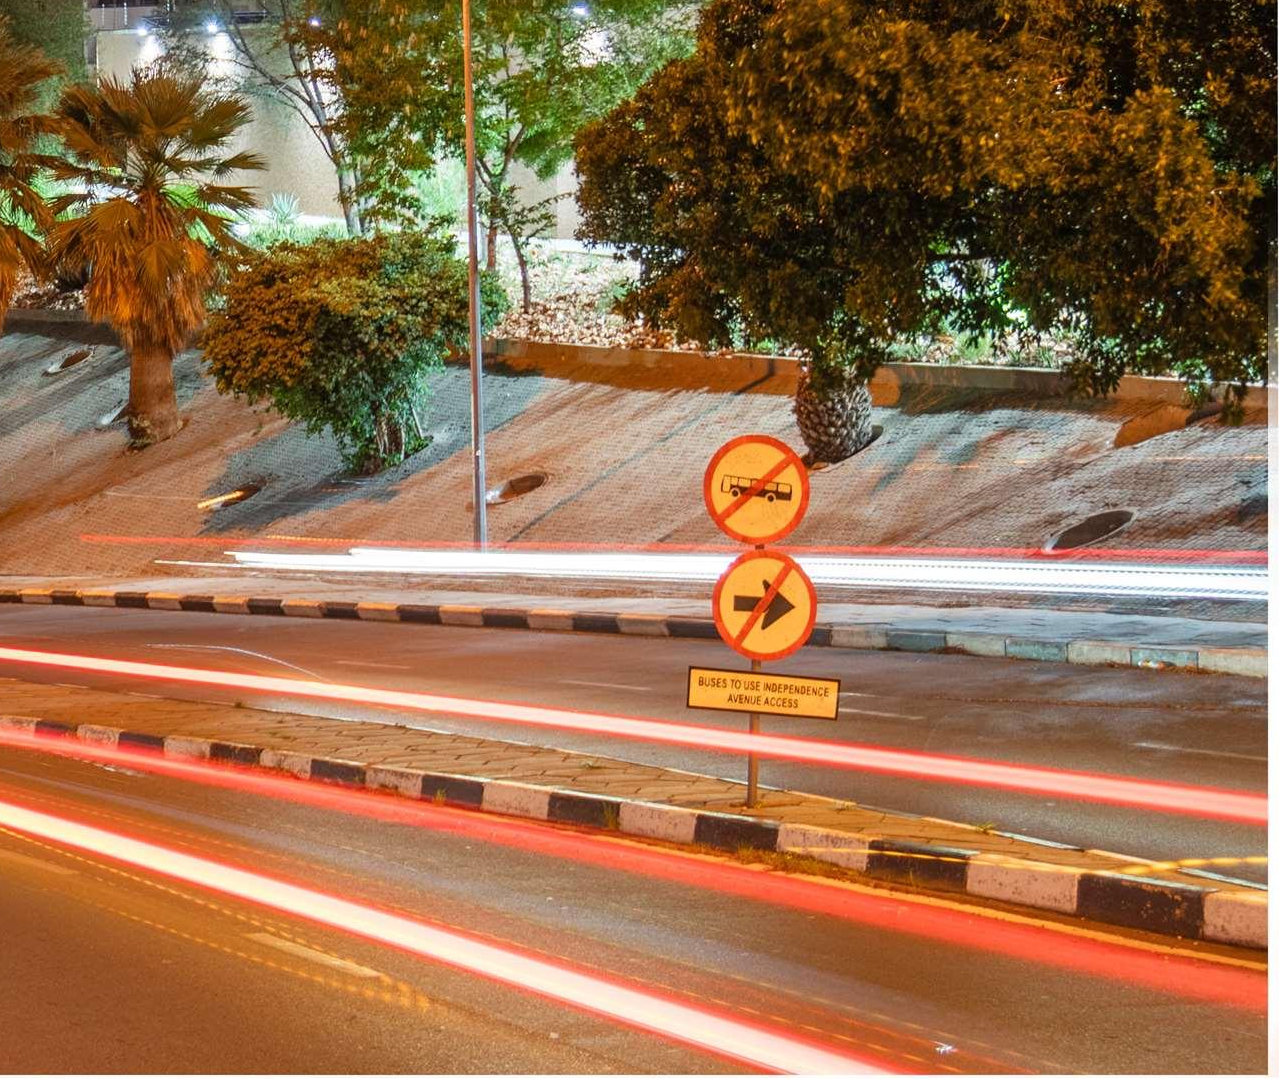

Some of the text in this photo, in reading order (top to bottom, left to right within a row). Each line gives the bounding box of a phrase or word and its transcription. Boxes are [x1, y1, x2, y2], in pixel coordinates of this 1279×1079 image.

[698, 676, 830, 698] BUSES TO USE INDEPENDENCE
[727, 693, 799, 709] AVENUE ACCESS
